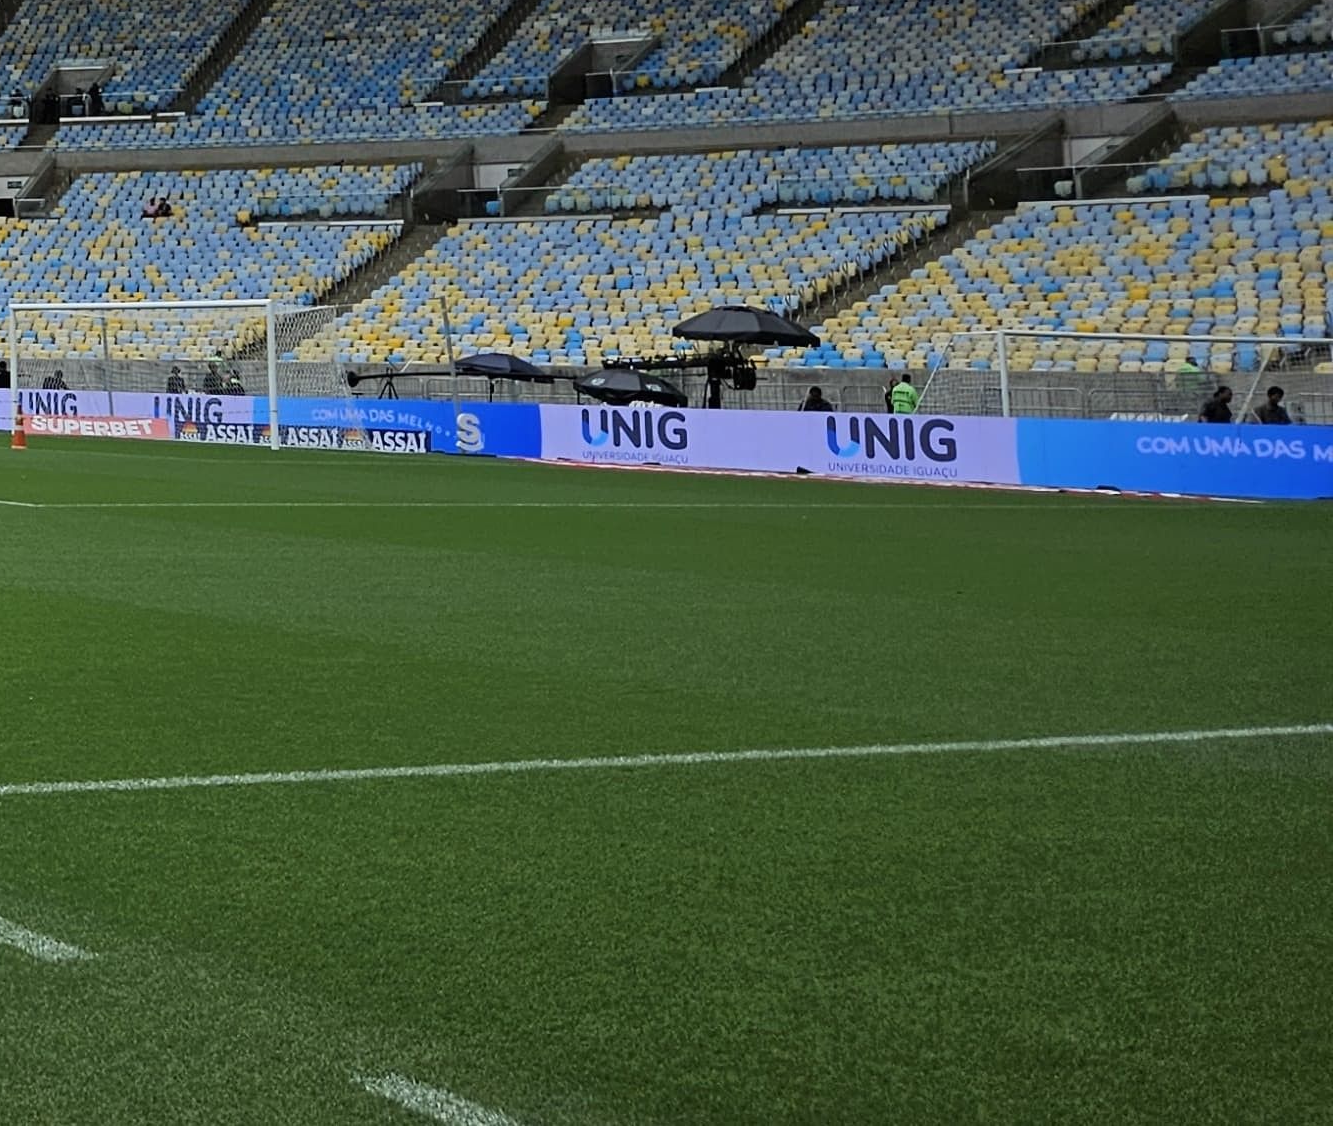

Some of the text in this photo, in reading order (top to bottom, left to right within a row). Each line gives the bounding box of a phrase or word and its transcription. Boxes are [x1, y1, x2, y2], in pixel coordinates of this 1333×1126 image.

[31, 416, 153, 437] SUPERBET
[581, 409, 688, 450] UNIG
[827, 416, 958, 462] UNIG
[1136, 436, 1190, 455] COM
[1194, 436, 1251, 457] UMA
[1253, 437, 1307, 459] DAS
[582, 451, 648, 462] UNIVERSIDADE
[828, 462, 958, 478] UNIVERSIDADE IGUAÇU
